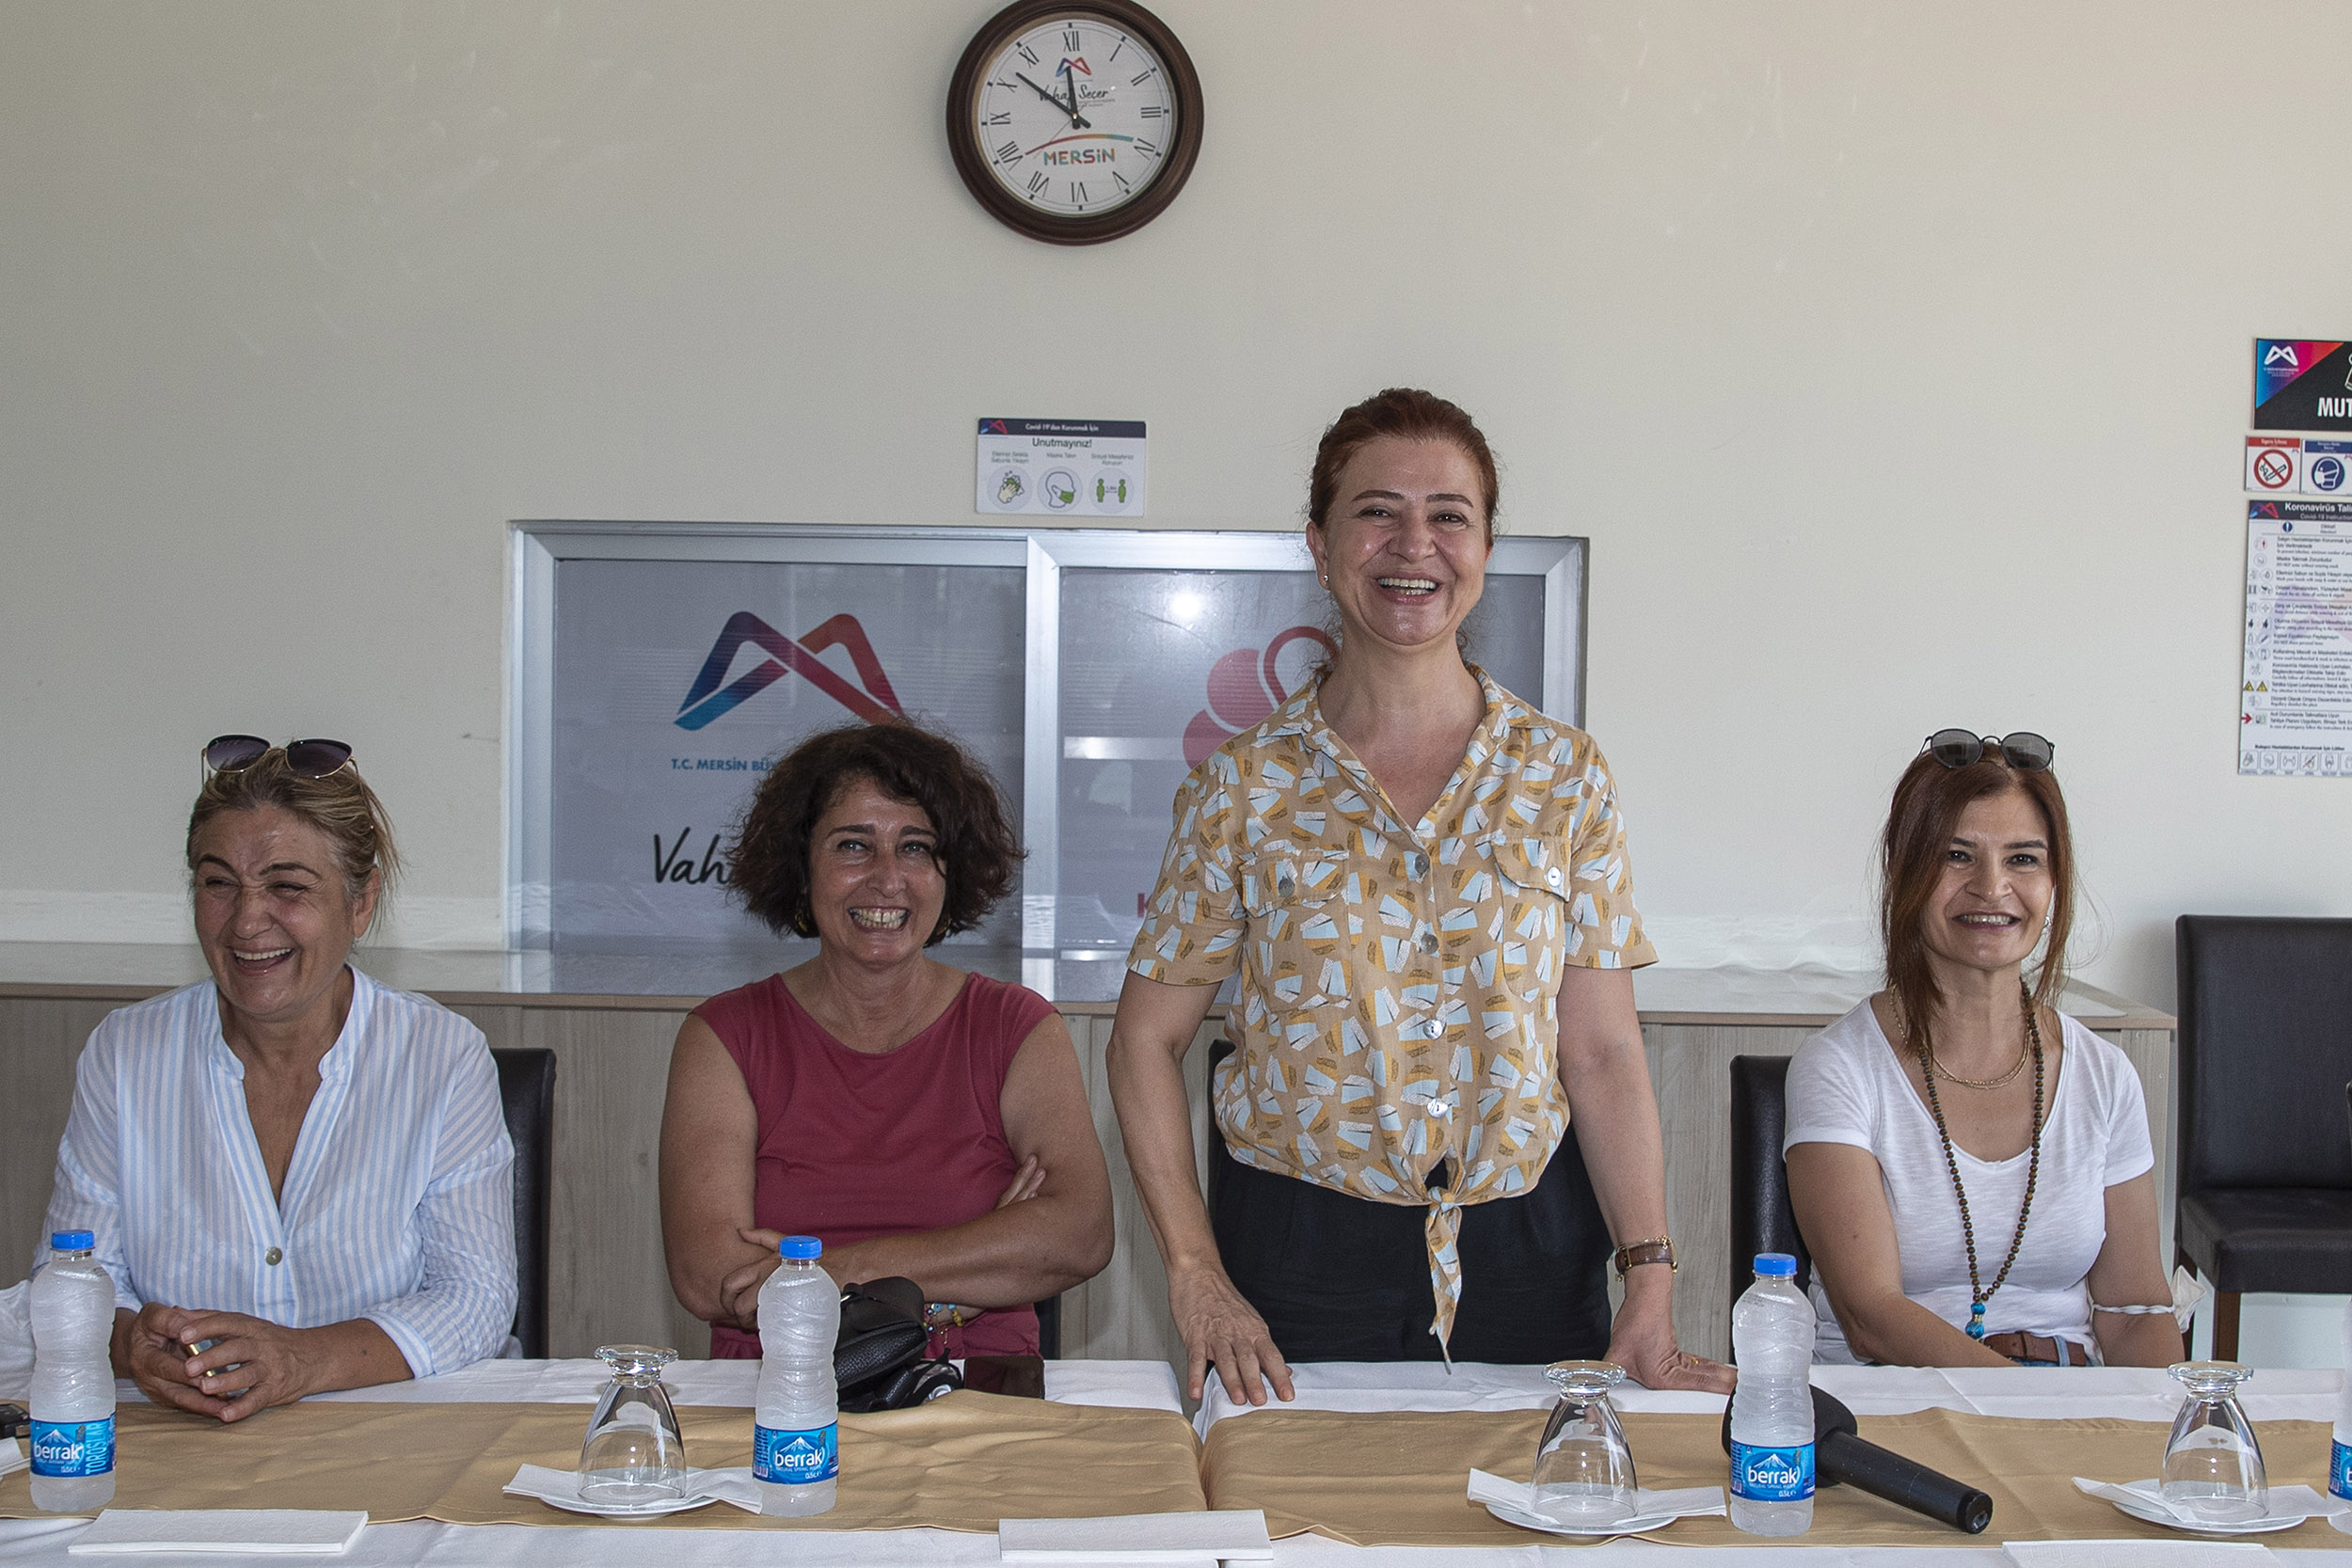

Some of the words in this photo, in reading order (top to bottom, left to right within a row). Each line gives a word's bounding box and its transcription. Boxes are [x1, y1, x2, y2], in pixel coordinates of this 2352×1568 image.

[1062, 30, 1080, 53] XII
[1019, 45, 1040, 69] XI
[996, 77, 1018, 93] X
[1131, 71, 1152, 87] II
[990, 112, 1011, 125] IX
[1140, 106, 1162, 119] III
[996, 141, 1024, 171] VIII
[1134, 137, 1156, 161] IV
[1026, 170, 1050, 198] VII
[1112, 170, 1129, 191] V
[1071, 182, 1089, 203] VI
[1032, 437, 1092, 450] Unutmayınız!
[2284, 502, 2335, 513] Koronavirüs
[2337, 504, 2352, 513] Tali
[671, 758, 693, 770] T.C.
[696, 757, 748, 771] MERSİN
[34, 1441, 84, 1461] berrak
[774, 1449, 823, 1467] berrak
[1747, 1466, 1798, 1484] berrak
